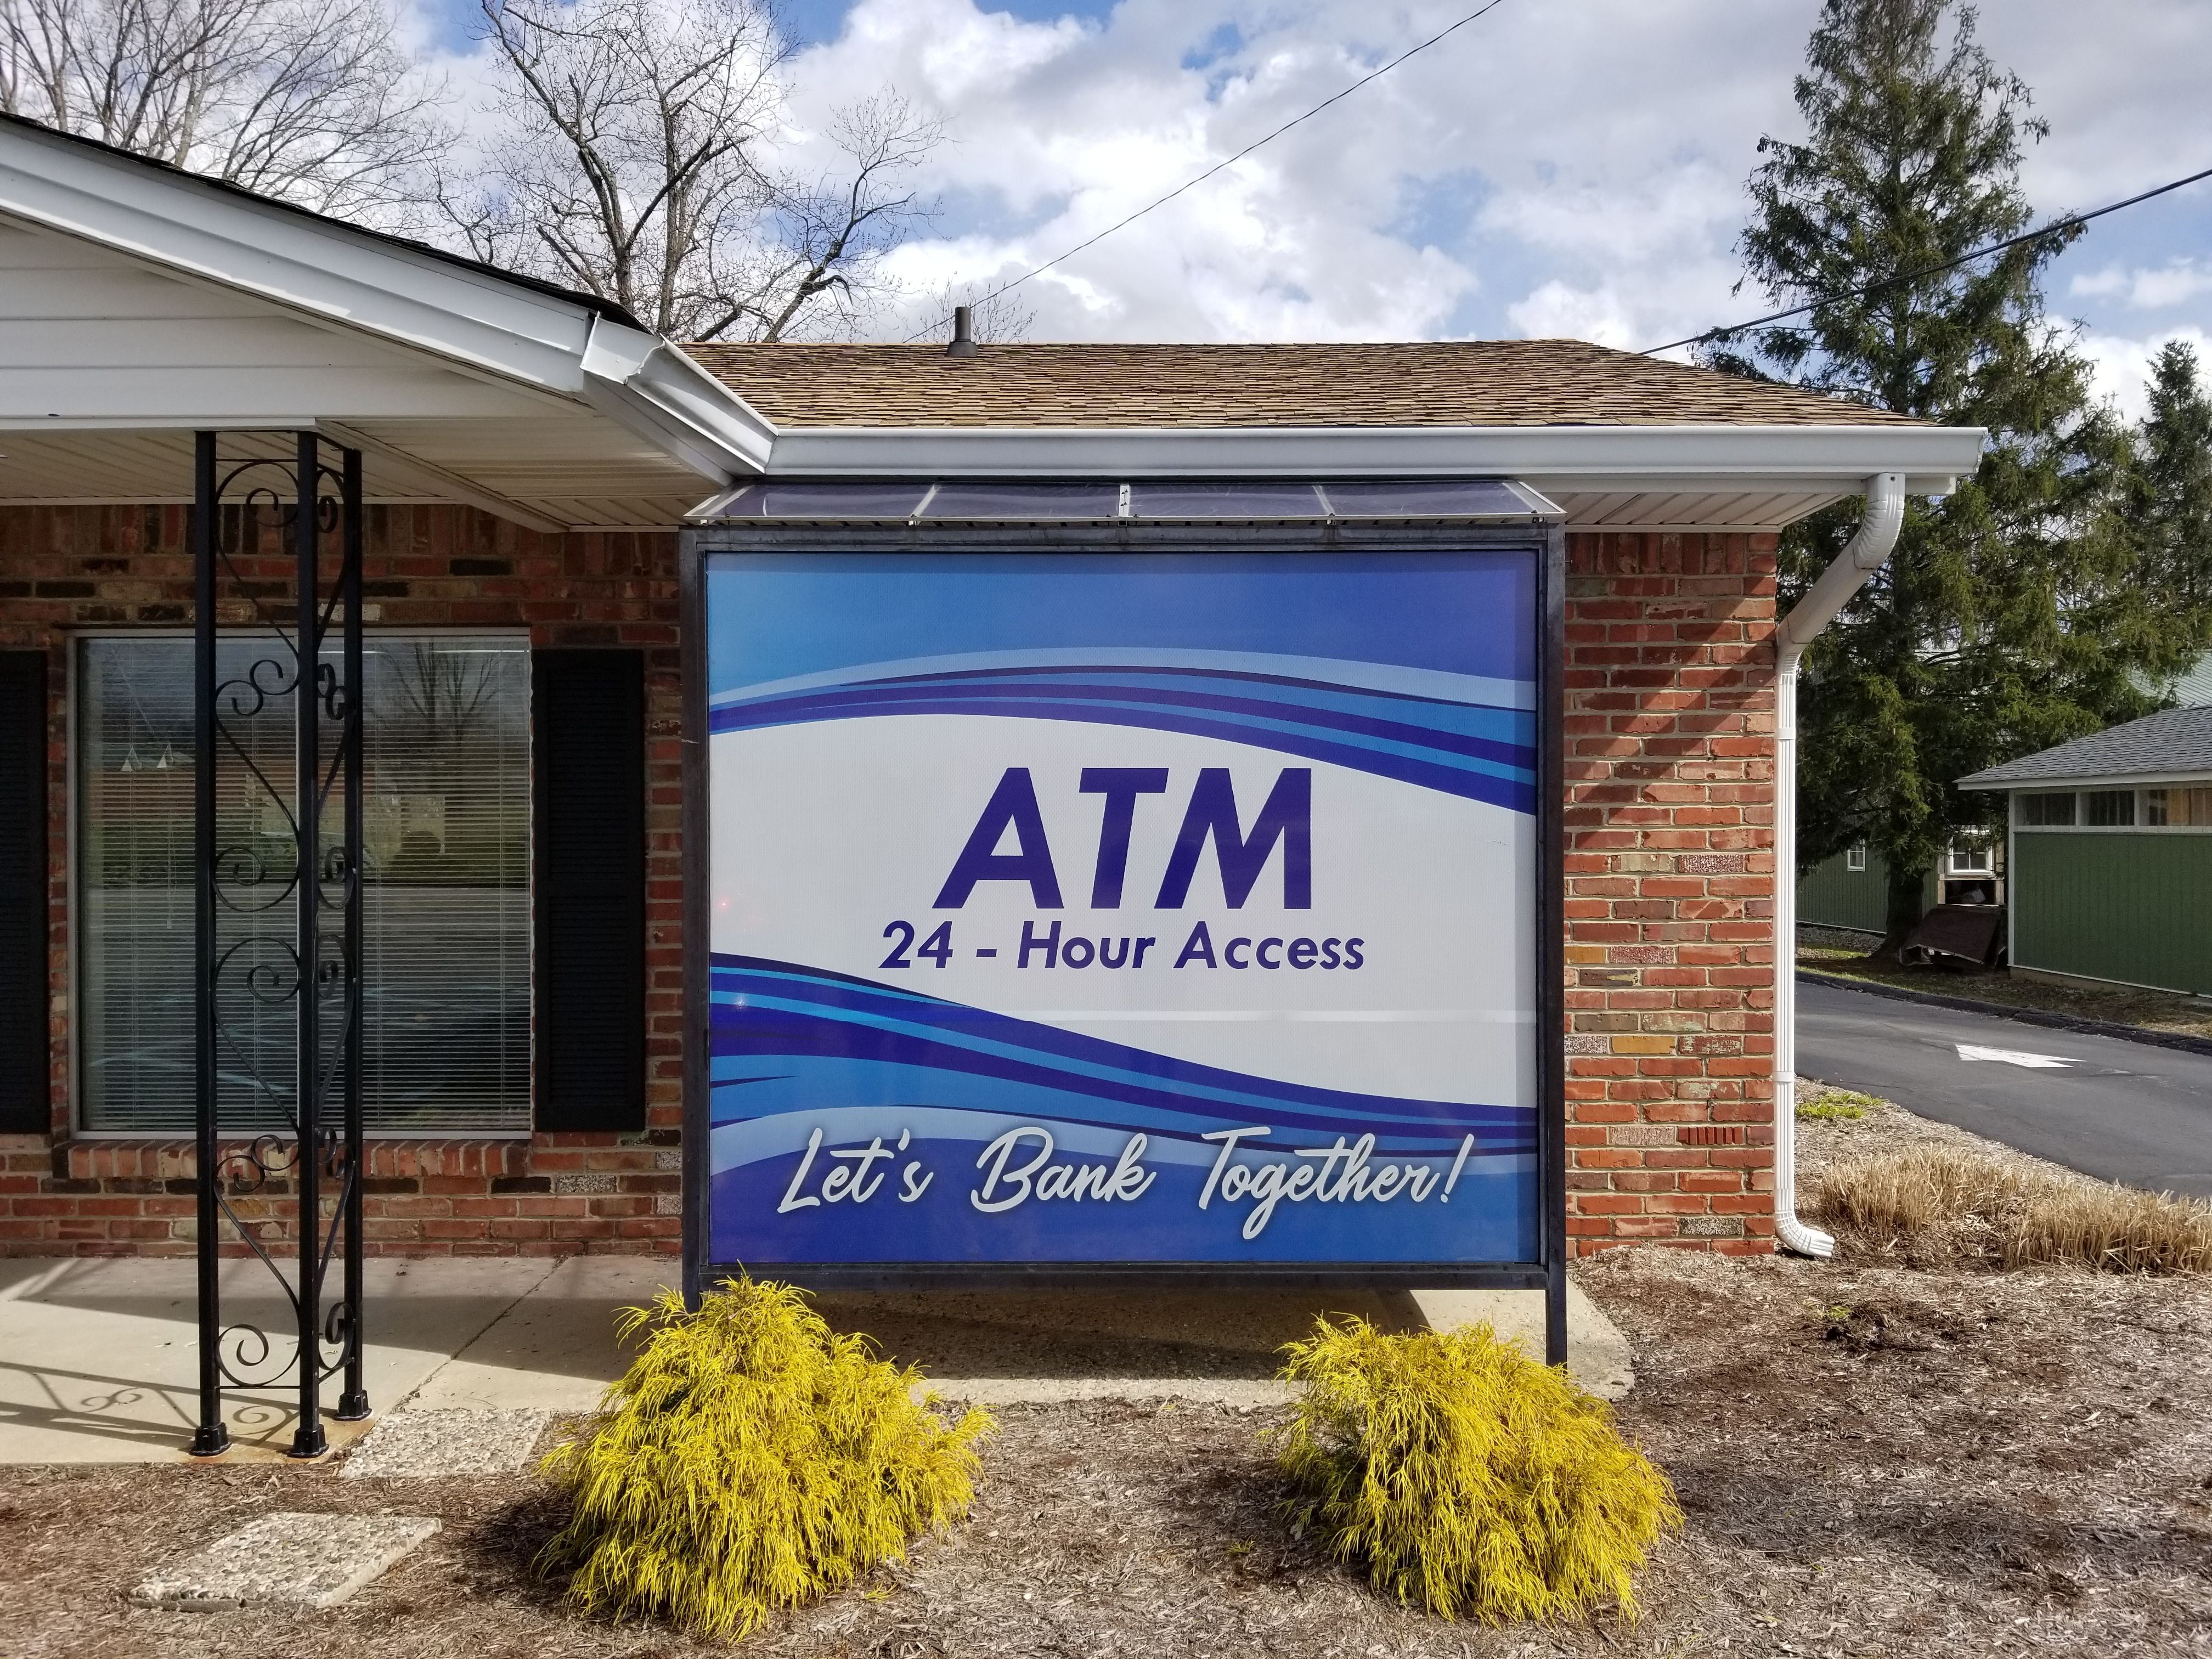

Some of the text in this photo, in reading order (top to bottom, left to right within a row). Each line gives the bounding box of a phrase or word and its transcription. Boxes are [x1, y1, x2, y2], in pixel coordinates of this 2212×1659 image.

[932, 767, 1311, 909] ATM
[878, 919, 953, 970] 24
[1017, 919, 1155, 970] Hour
[1173, 919, 1365, 970] Access
[776, 1126, 1475, 1240] Let's Bank Together!
